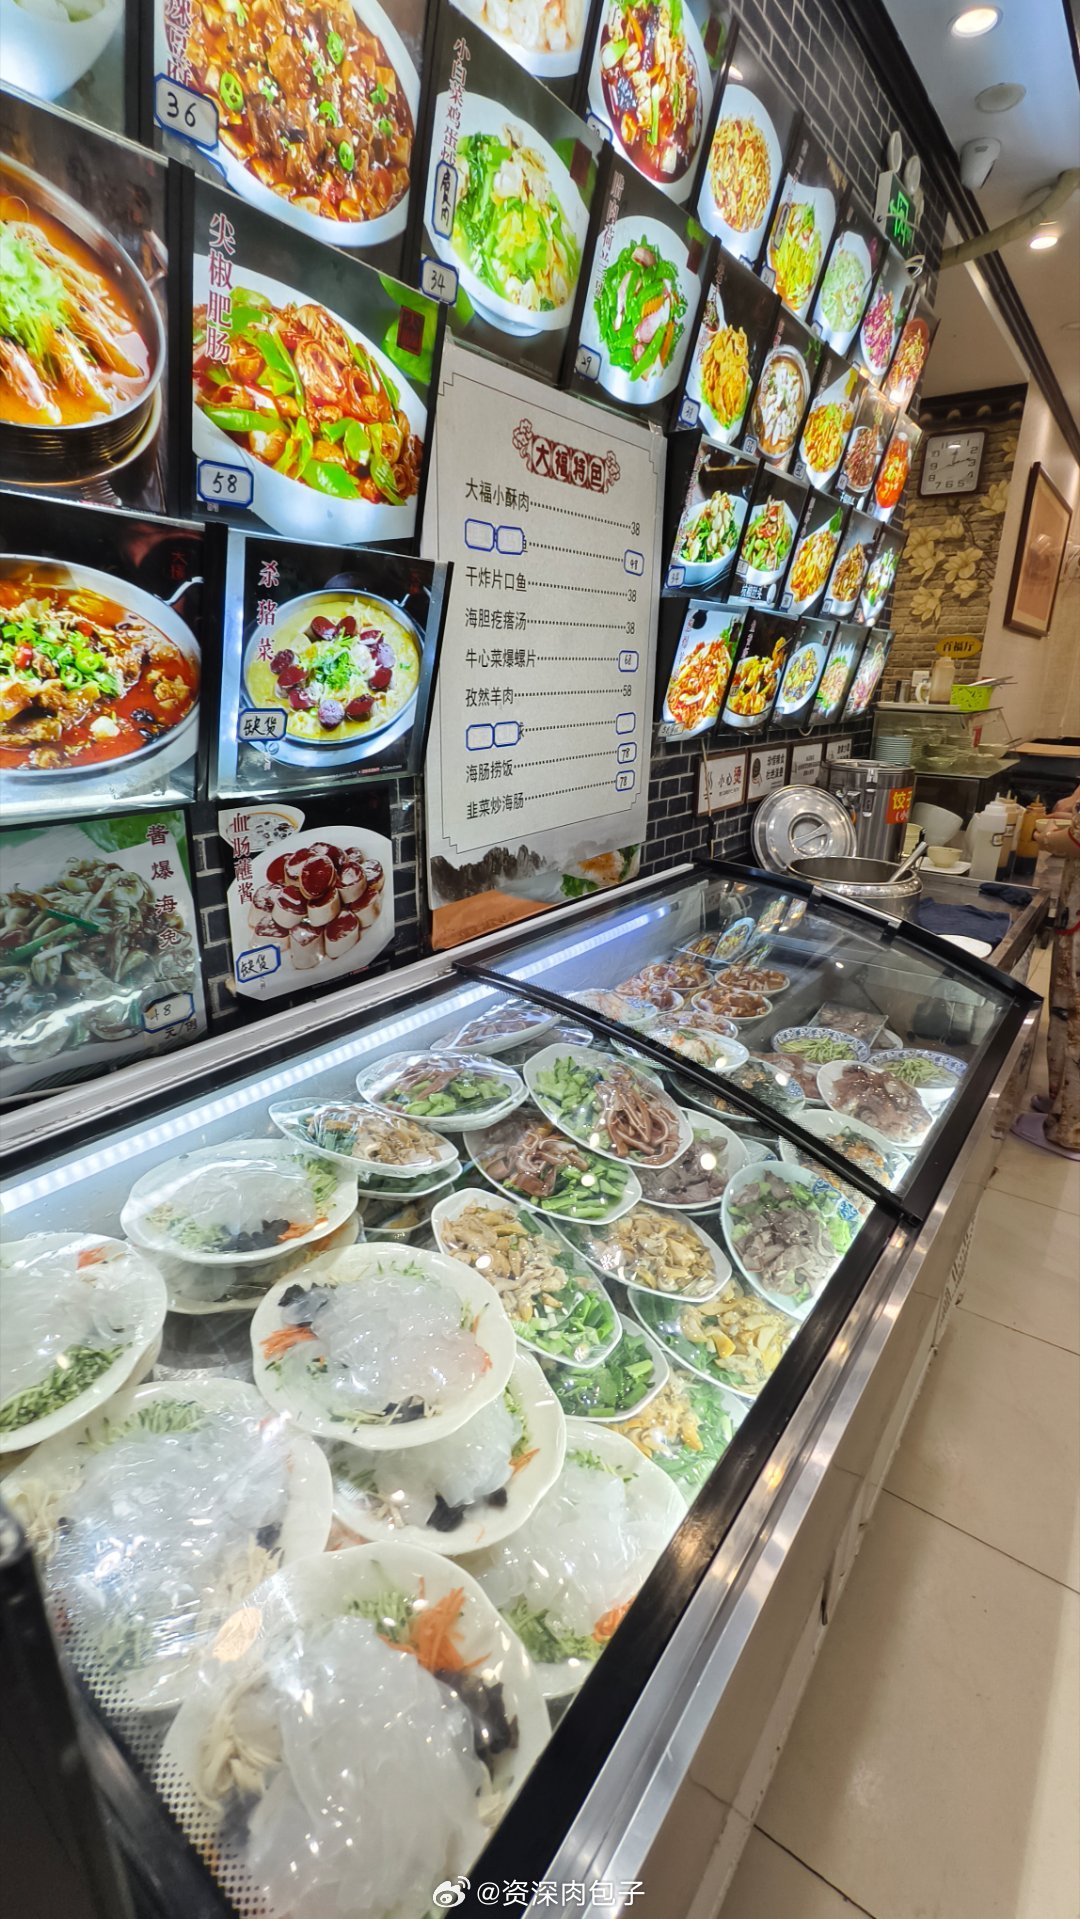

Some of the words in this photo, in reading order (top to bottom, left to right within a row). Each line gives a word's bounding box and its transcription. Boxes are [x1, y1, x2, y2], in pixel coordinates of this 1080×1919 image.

[166, 91, 196, 127] 36
[207, 213, 236, 365] 尖椒肥肠
[431, 269, 445, 295] 34
[535, 443, 603, 488] 大福特色
[212, 471, 238, 494] 58
[465, 477, 530, 513] 大福小酥肉
[630, 521, 641, 537] 38
[465, 565, 527, 593] 干炸片口鱼
[627, 589, 637, 602] 38
[257, 560, 281, 662] 杀猪菜
[464, 607, 527, 631] 海胆疙瘩汤
[625, 621, 635, 635] 38
[465, 648, 537, 669] 牛心菜爆螺片
[465, 686, 514, 708] 孜然羊肉
[622, 684, 632, 697] 58
[243, 715, 277, 738] 缺货
[465, 759, 514, 784] 海肠捞饭
[466, 792, 525, 820] 韭菜炒海肠
[241, 954, 269, 977] 缺货
